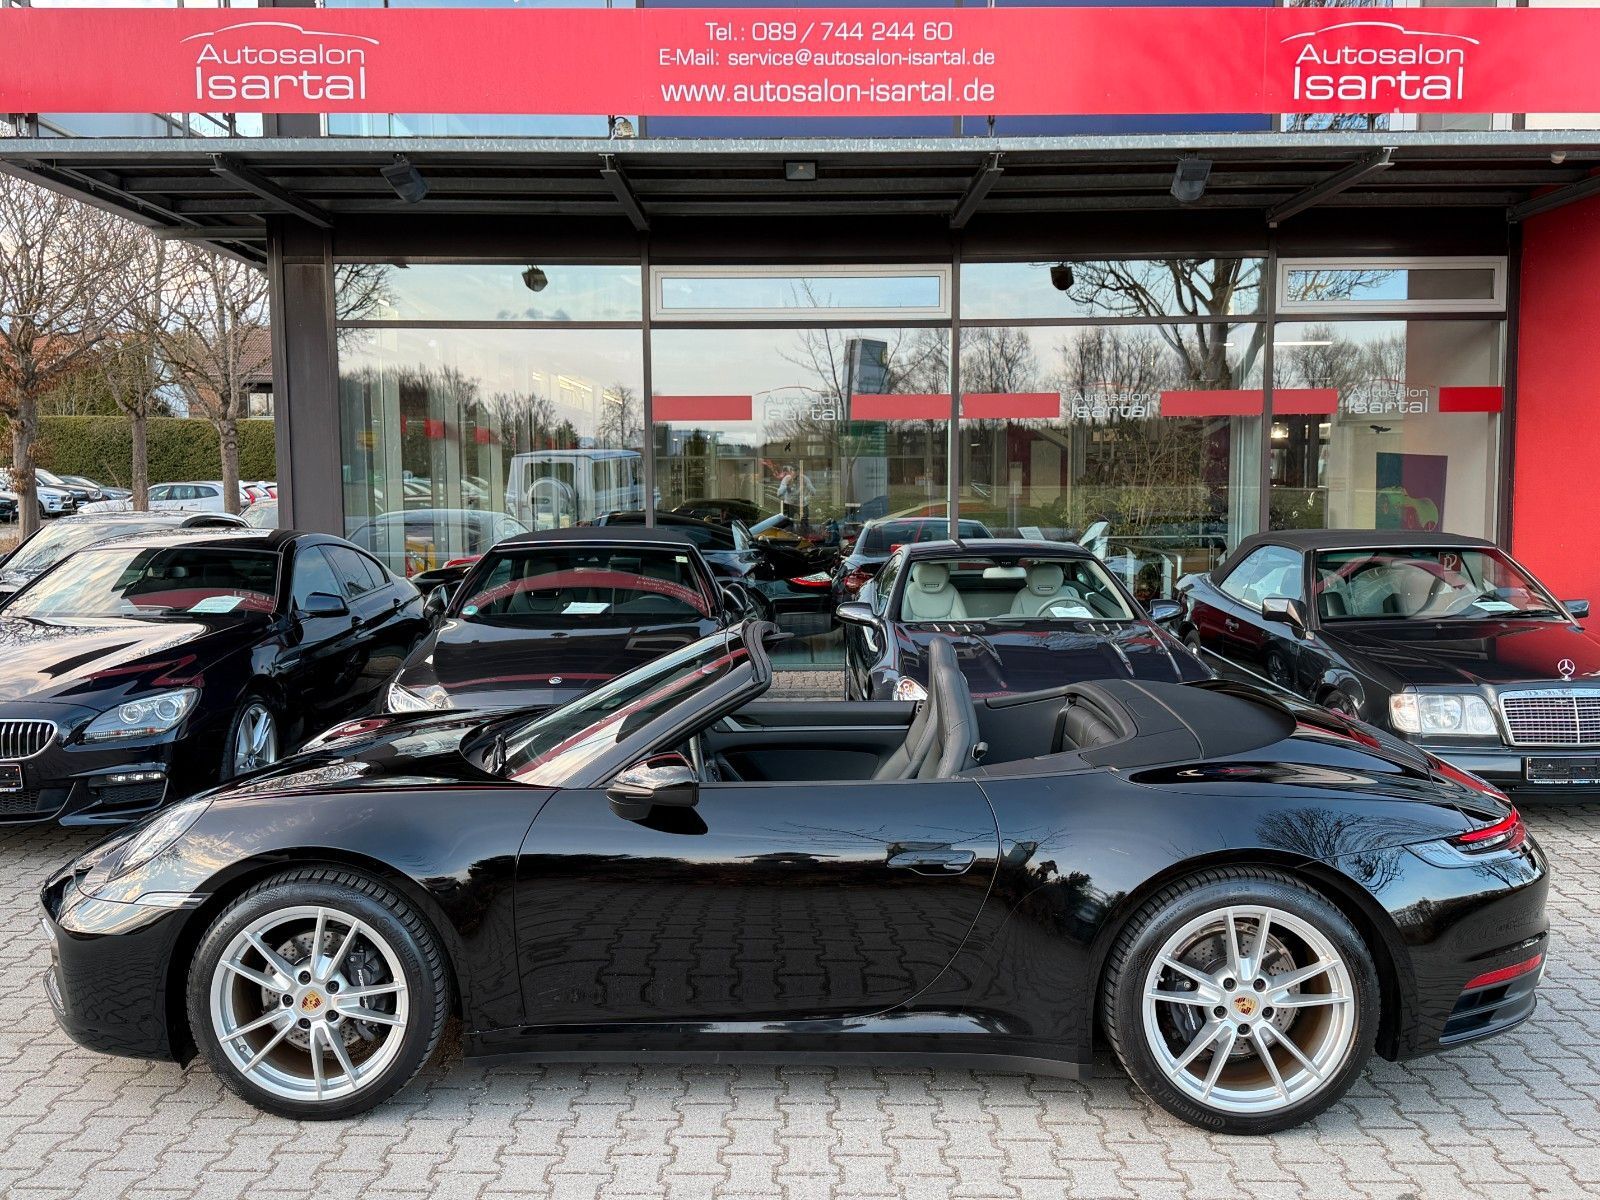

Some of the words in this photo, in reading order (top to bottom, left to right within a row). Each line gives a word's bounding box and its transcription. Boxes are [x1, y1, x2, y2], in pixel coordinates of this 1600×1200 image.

[704, 22, 745, 41] Tel.:
[751, 22, 797, 41] 089
[820, 22, 864, 41] 744
[871, 22, 916, 41] 244
[923, 21, 953, 41] 60
[196, 43, 365, 65] Autosalon
[659, 48, 719, 66] E-Mail:
[728, 48, 995, 66] service@autosalon-isartal.de
[1296, 43, 1464, 65] Autosalon
[195, 66, 366, 100] Isartal
[660, 77, 995, 103] www.autosalon-isartal.de
[1293, 66, 1464, 100] Isartal
[1072, 390, 1151, 402] Autosalon
[1348, 397, 1429, 414] Isartal
[1071, 401, 1152, 419] Isartal
